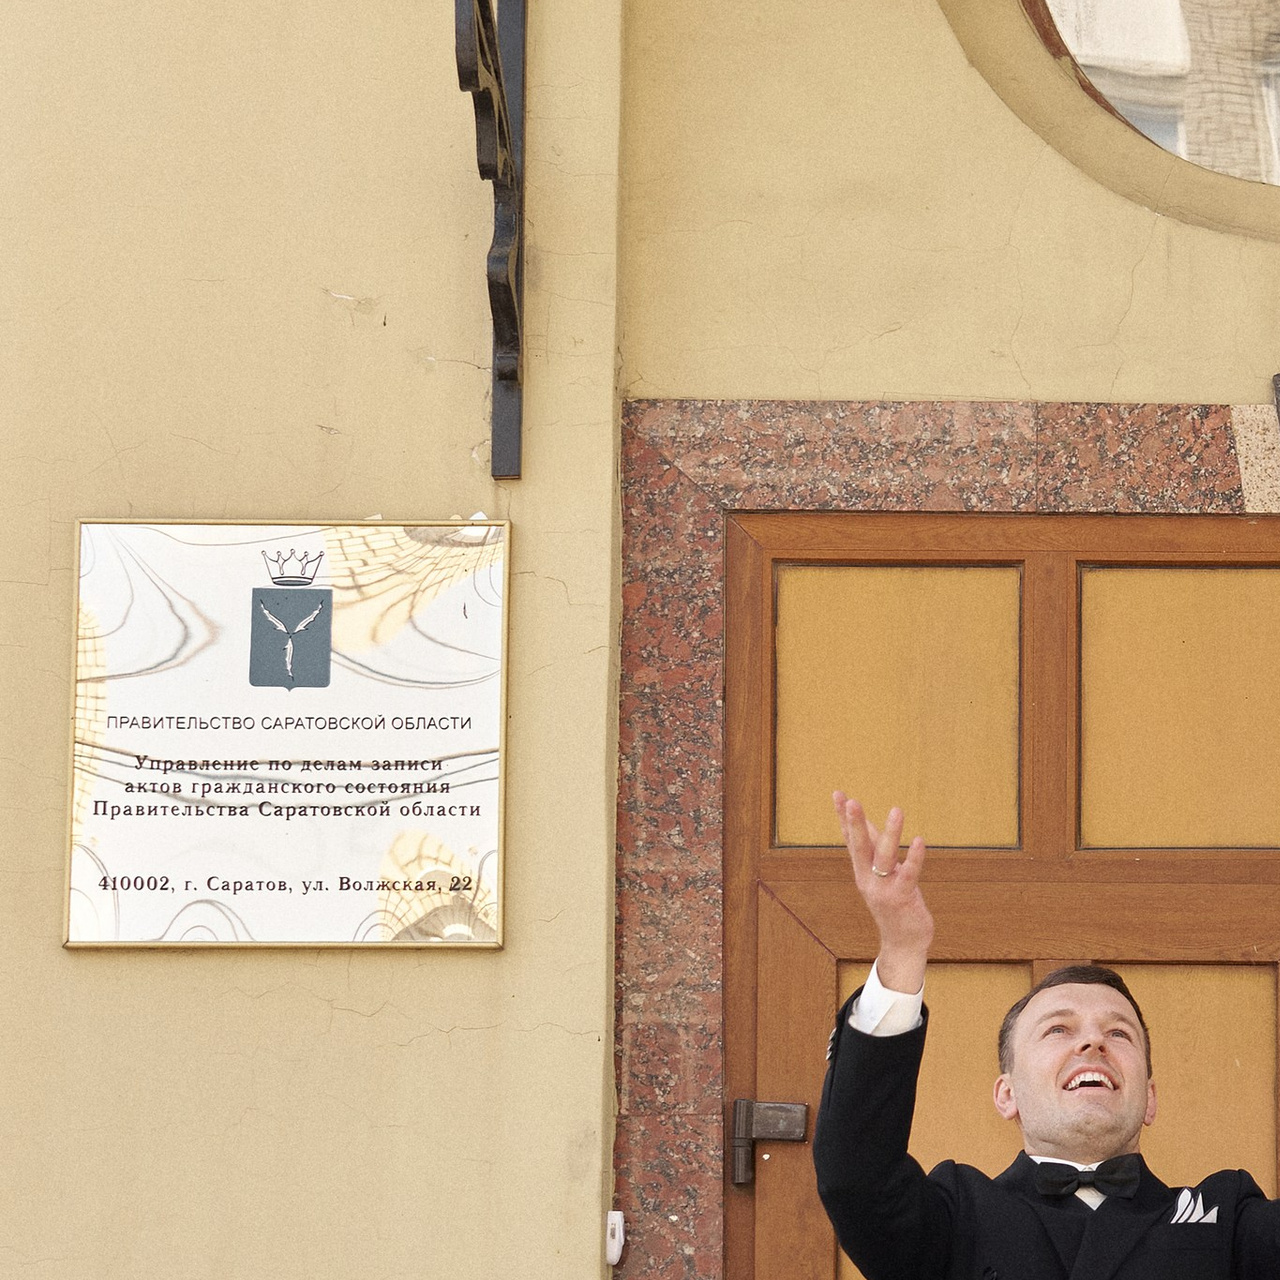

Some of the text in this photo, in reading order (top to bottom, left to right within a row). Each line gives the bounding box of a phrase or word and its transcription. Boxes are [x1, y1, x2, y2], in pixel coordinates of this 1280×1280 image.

[107, 714, 472, 730] ПРАВИТЕЛЬСТВО САРАТОВСКОЙ ОБЛАСТИ
[134, 755, 443, 774] Управление по делам записи
[125, 782, 451, 798] актов гражданского состояния
[93, 800, 481, 820] Правительства Саратовской области
[98, 876, 472, 895] 410002, г. Саратов, ул. Волжская, 22
